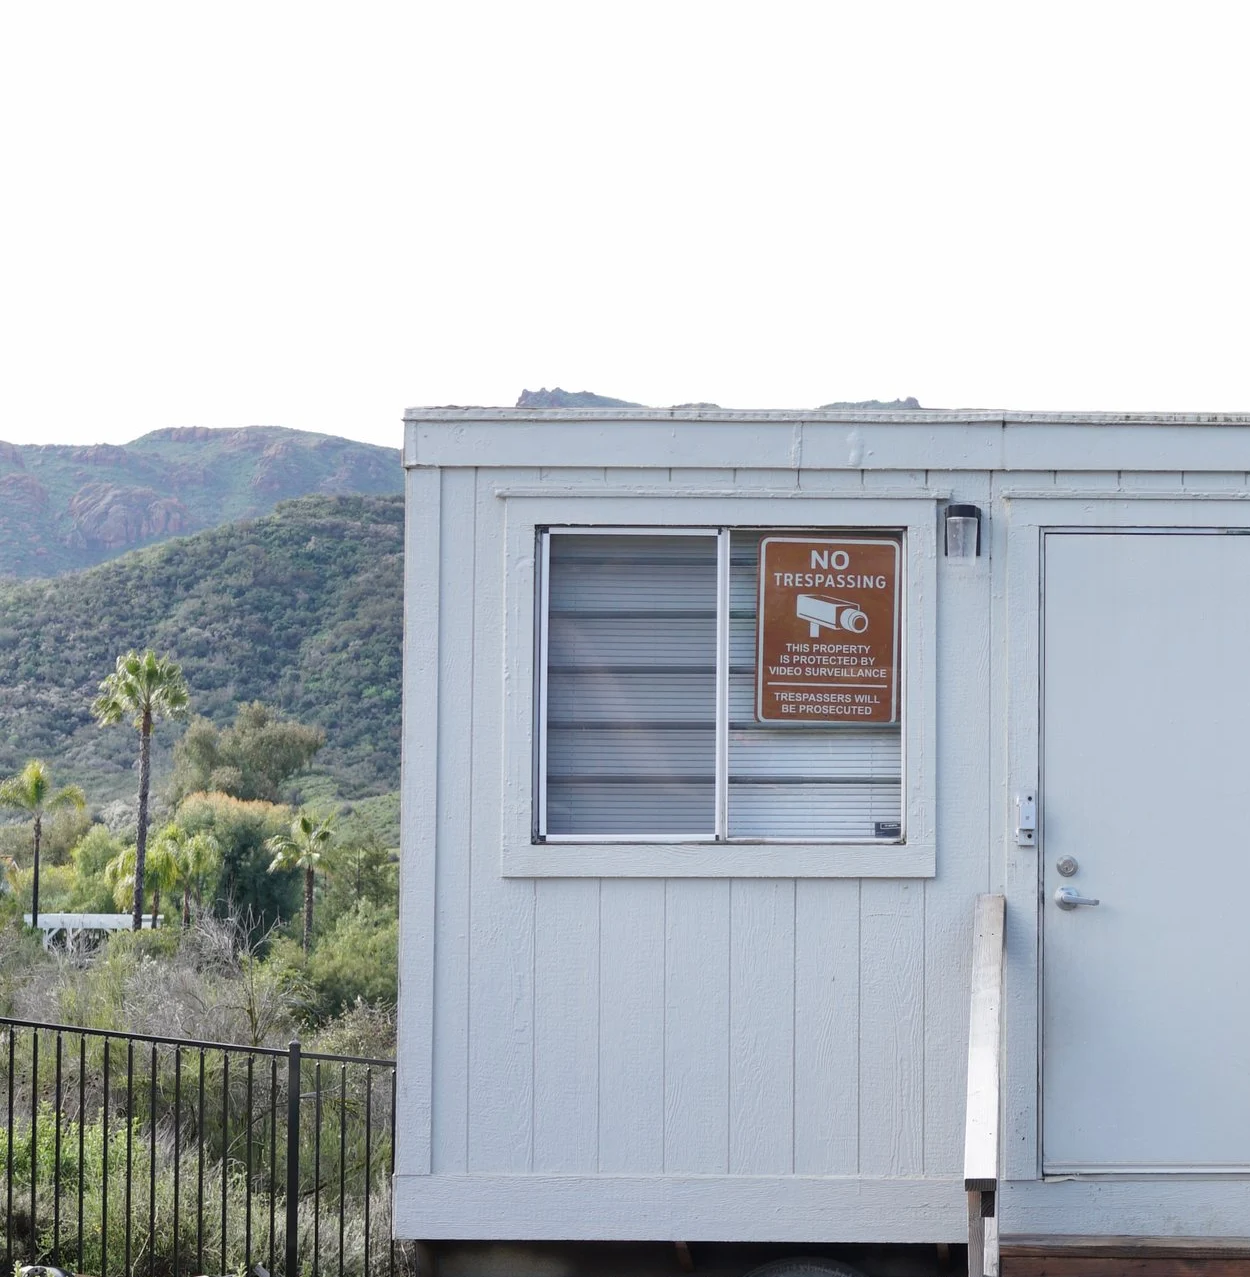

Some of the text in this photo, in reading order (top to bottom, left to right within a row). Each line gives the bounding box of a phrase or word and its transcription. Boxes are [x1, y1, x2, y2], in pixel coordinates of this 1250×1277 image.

[811, 550, 850, 570] NO
[774, 573, 886, 589] TRESPASSING
[786, 643, 871, 654] THIS PROPERTY
[780, 655, 875, 666] IS PROTECTED BY
[769, 666, 887, 678] VIDEO SURVEILLANCE
[774, 692, 880, 704] TRESPASSERS WILL
[781, 704, 872, 715] BE PROSECUTED
